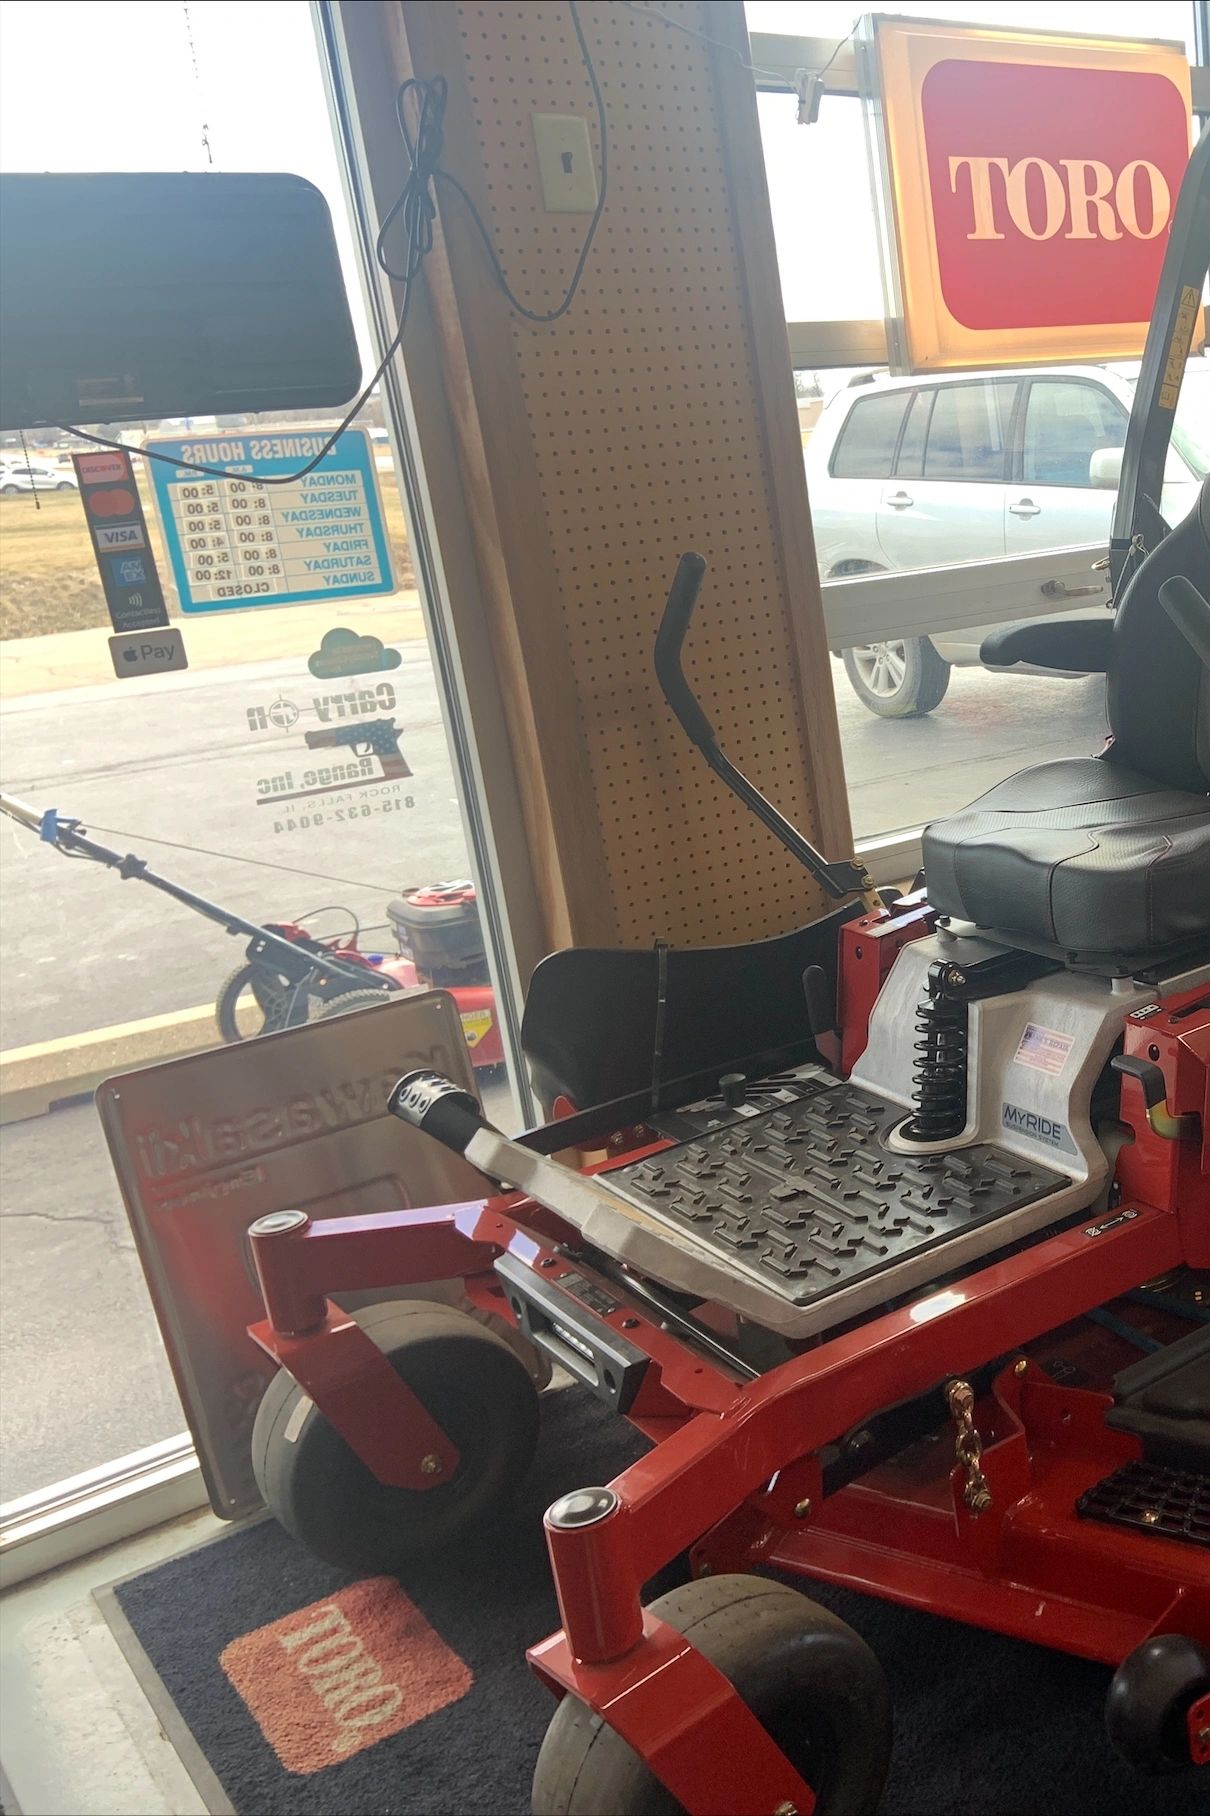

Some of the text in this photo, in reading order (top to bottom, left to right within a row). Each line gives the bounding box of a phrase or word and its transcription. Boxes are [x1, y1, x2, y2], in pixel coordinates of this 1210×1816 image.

[948, 155, 1171, 241] TORO
[104, 530, 139, 544] VISA
[140, 644, 176, 662] Pay
[279, 1603, 404, 1730] TORO
